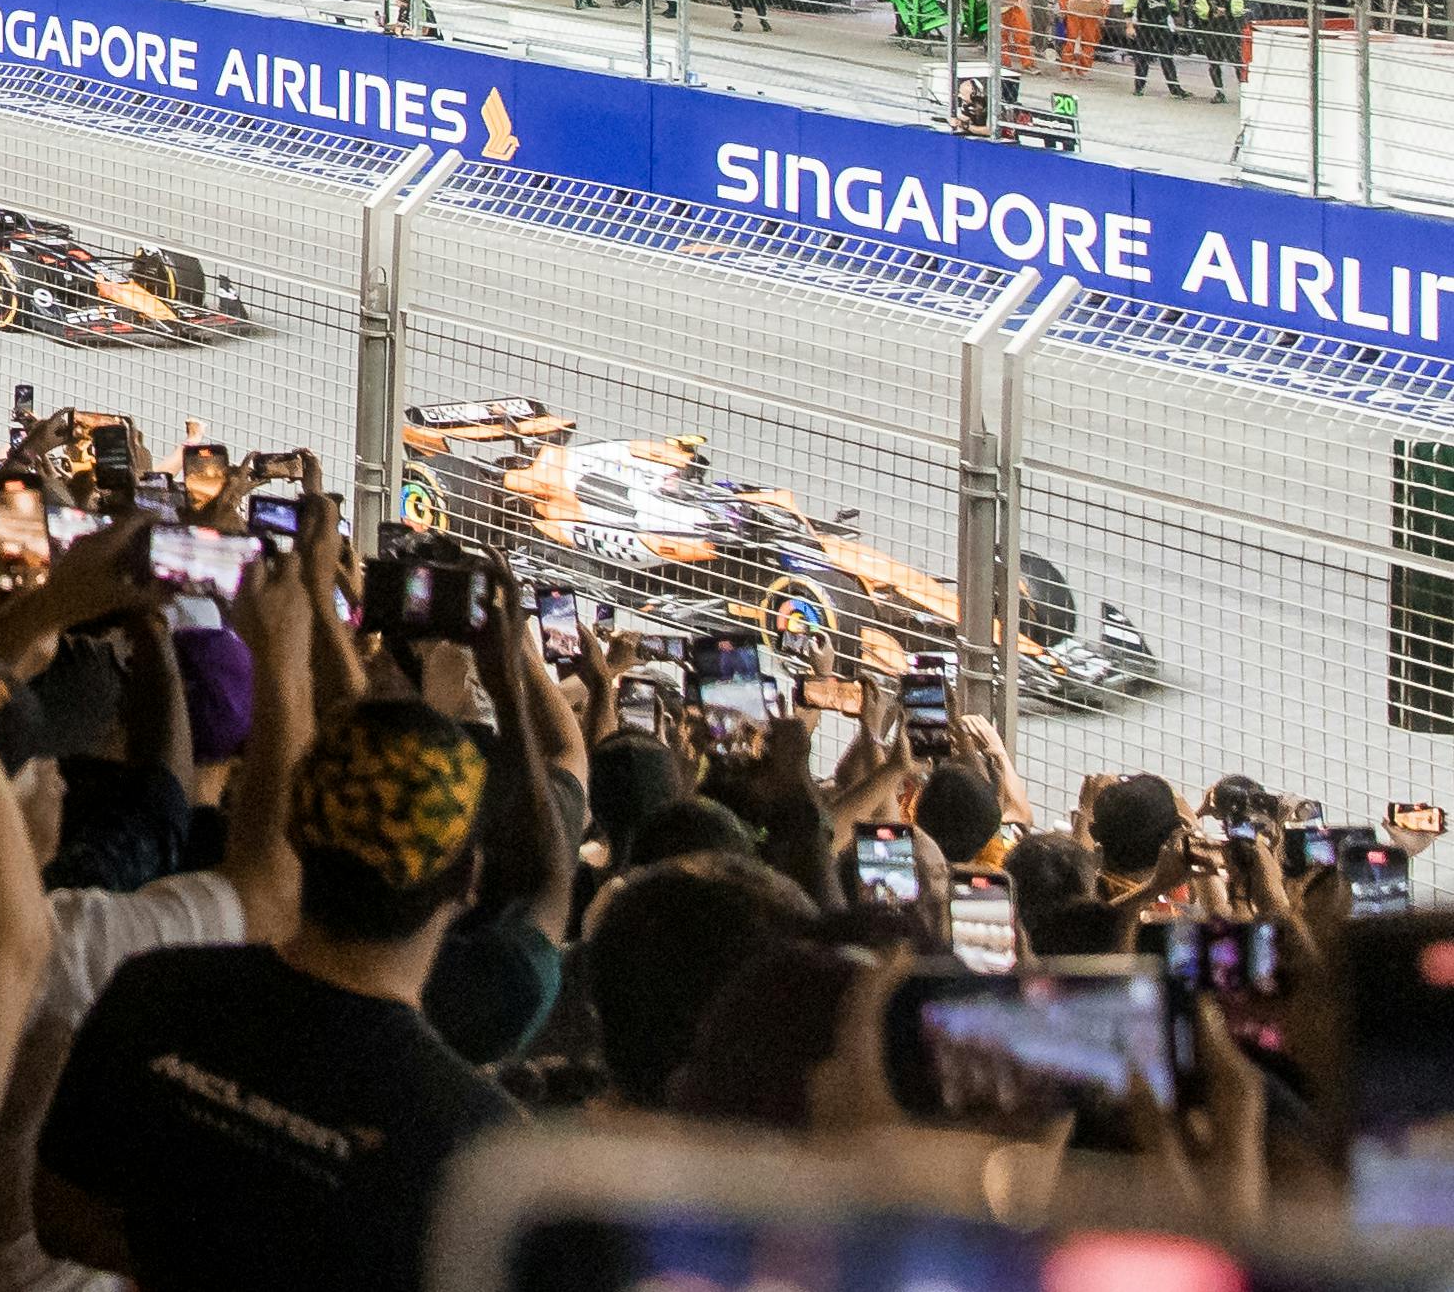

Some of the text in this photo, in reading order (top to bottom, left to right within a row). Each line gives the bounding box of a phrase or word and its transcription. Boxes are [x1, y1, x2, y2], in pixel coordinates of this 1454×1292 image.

[216, 49, 468, 143] AIRLINES
[1055, 96, 1074, 115] 20
[716, 142, 1153, 284] SINGAPORE
